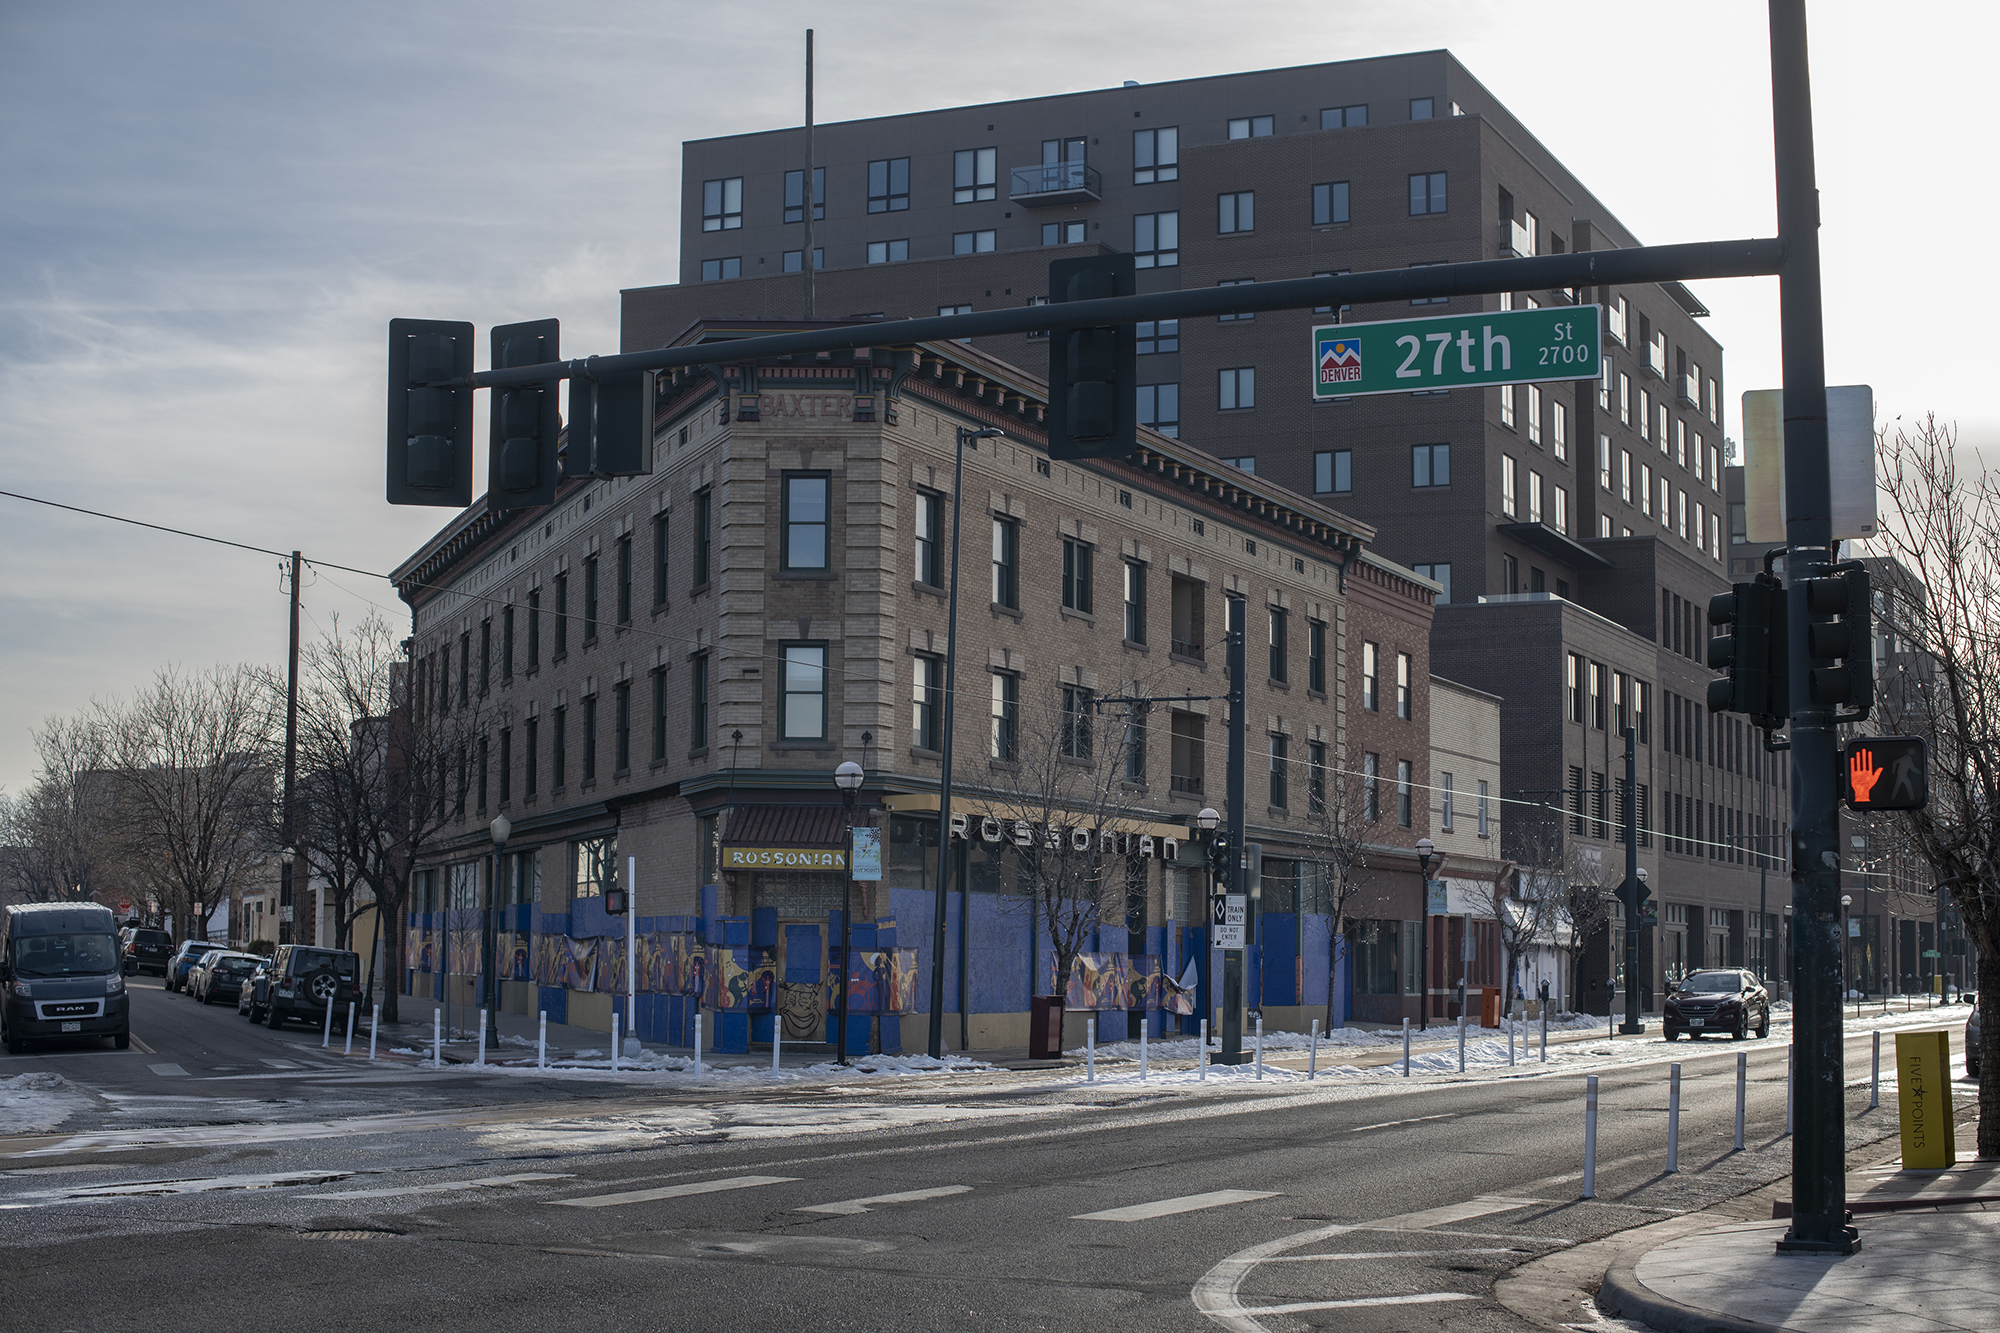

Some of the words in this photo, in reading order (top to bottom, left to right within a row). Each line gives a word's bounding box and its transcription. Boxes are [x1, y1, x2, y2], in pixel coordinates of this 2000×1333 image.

[1554, 321, 1573, 341] St
[1395, 325, 1511, 378] 27th
[1538, 344, 1589, 366] 2700
[1320, 366, 1361, 384] DENVER
[760, 394, 852, 417] BAXTER
[733, 851, 846, 866] ROSSONIAN
[1227, 914, 1243, 922] ONLY
[1910, 1056, 1922, 1084] FIVE
[1912, 1101, 1925, 1149] POINTS
